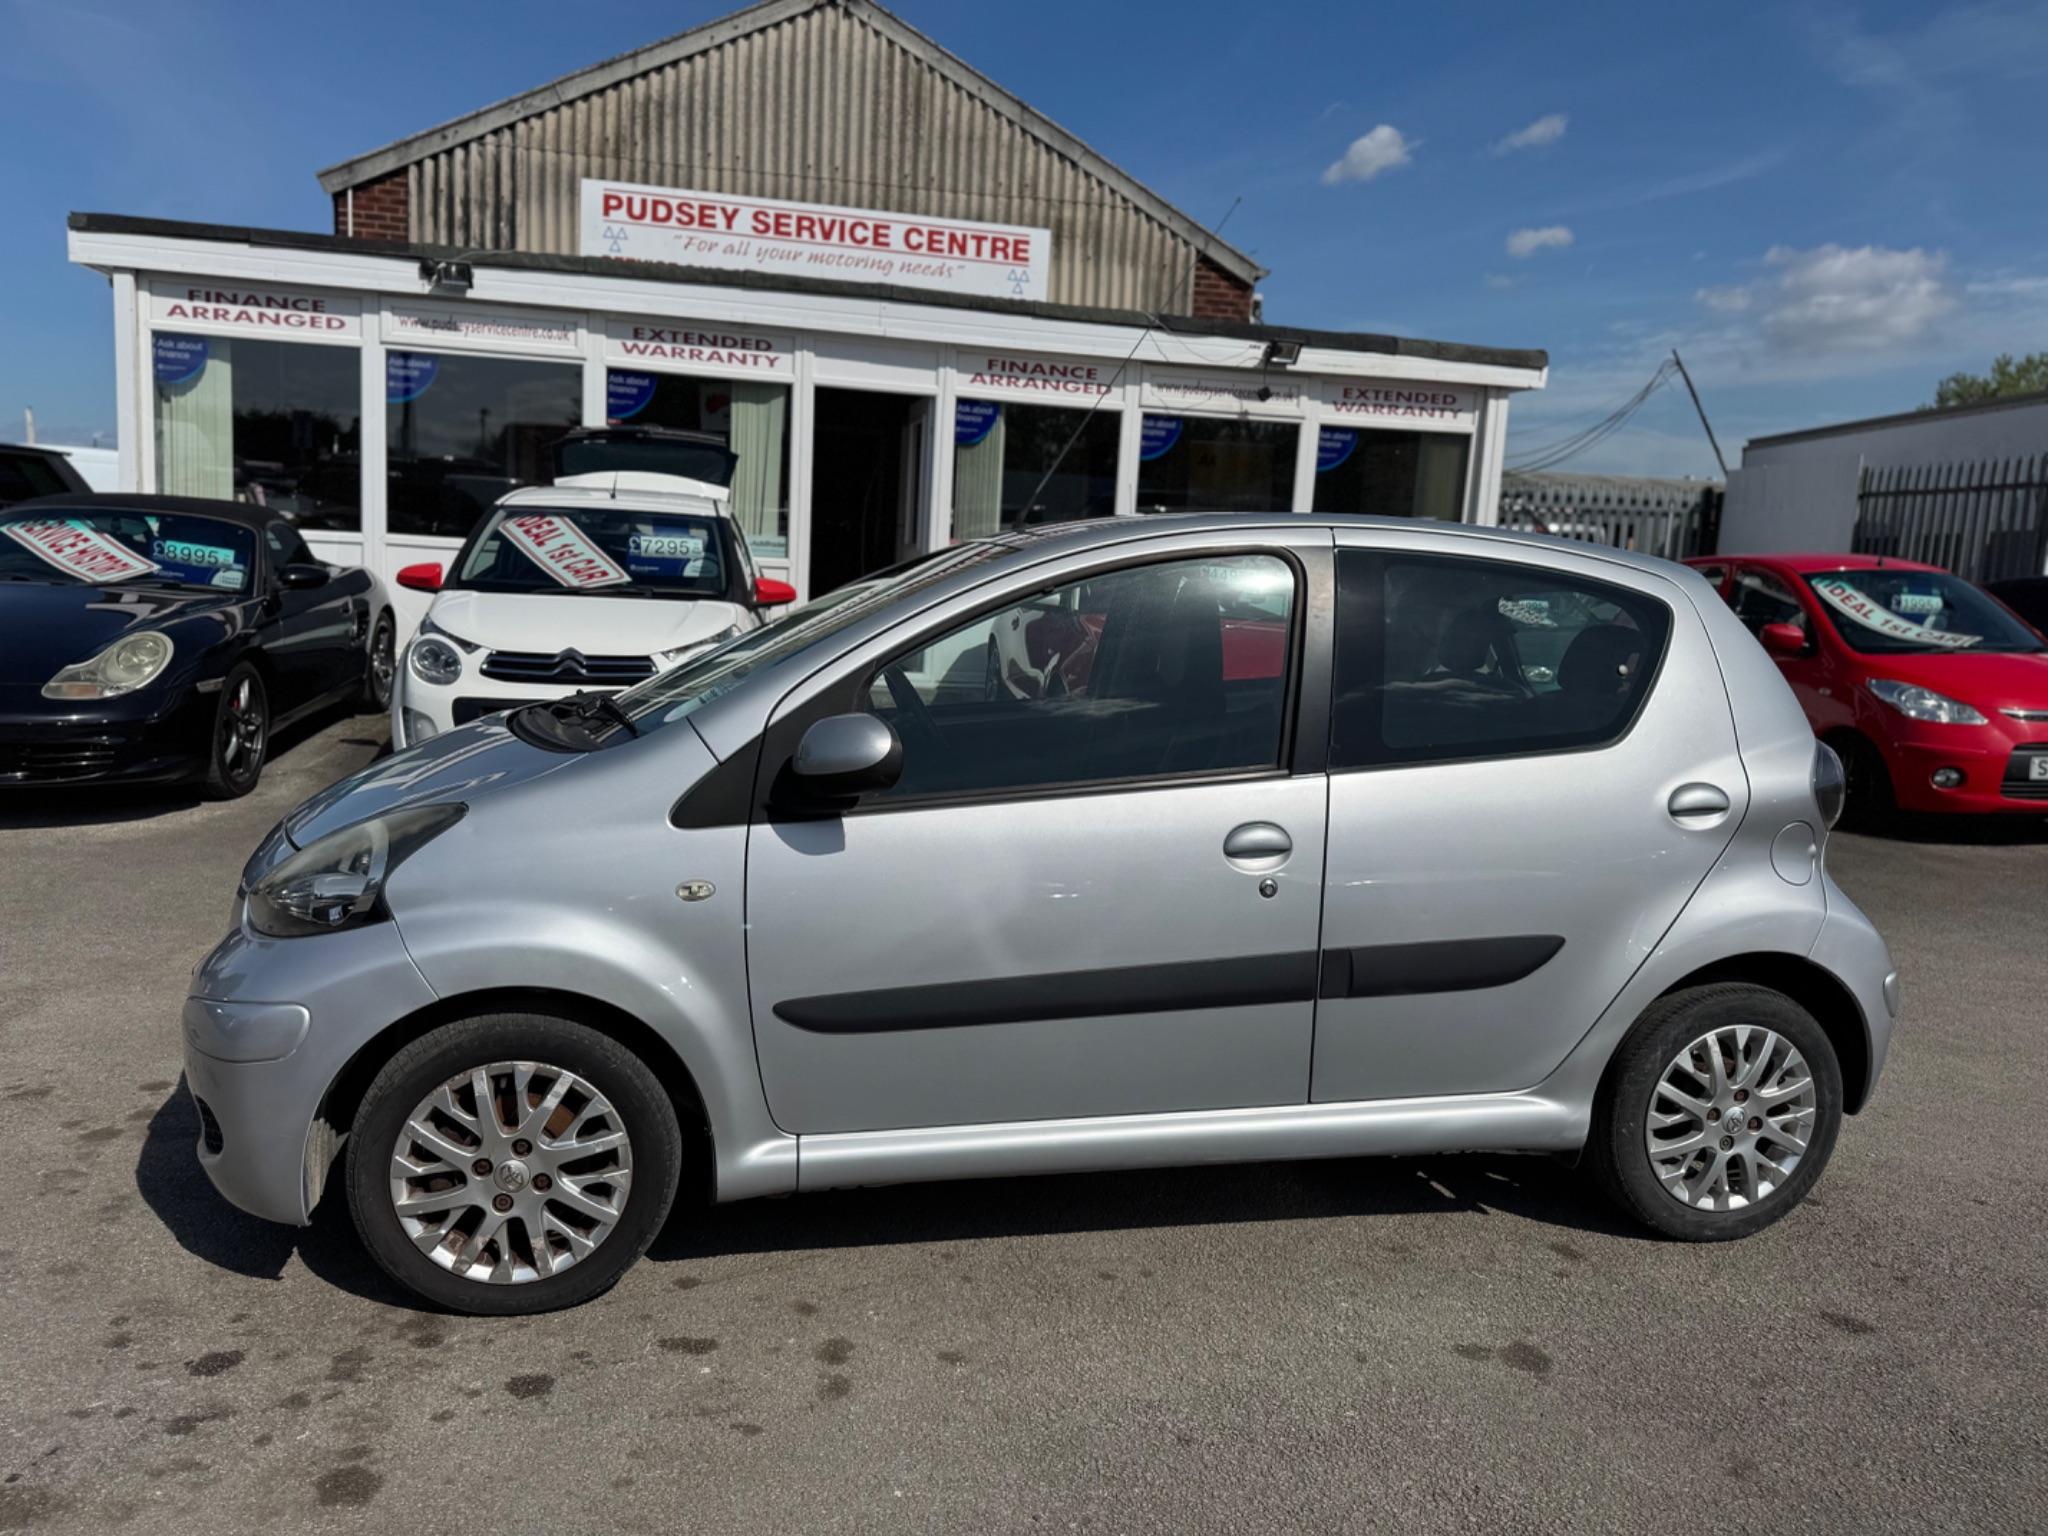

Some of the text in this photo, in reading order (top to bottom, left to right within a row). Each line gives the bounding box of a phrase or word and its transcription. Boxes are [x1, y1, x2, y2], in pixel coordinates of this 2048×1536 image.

[602, 193, 1030, 262] PUDSEY SERVICE CENTRE
[722, 240, 750, 257] all
[755, 245, 803, 263] your
[807, 250, 895, 277] motoring
[187, 289, 327, 313] FINANCE
[167, 304, 346, 330] ARRANGED
[157, 338, 203, 351] Ask about
[632, 327, 773, 352] EXTENDED
[157, 349, 190, 360] finance
[621, 341, 781, 368] WARRANTY
[609, 375, 649, 387] Ask about
[987, 358, 1098, 381] FINANCE
[609, 384, 638, 395] finance
[970, 372, 1112, 396] ARRANGED
[1343, 387, 1457, 406] EXTENDED
[1333, 400, 1463, 420] WARRANTY
[152, 540, 219, 566] £8995
[628, 536, 690, 556] £7295
[562, 559, 610, 583] CAR
[1915, 630, 1962, 645] CAR
